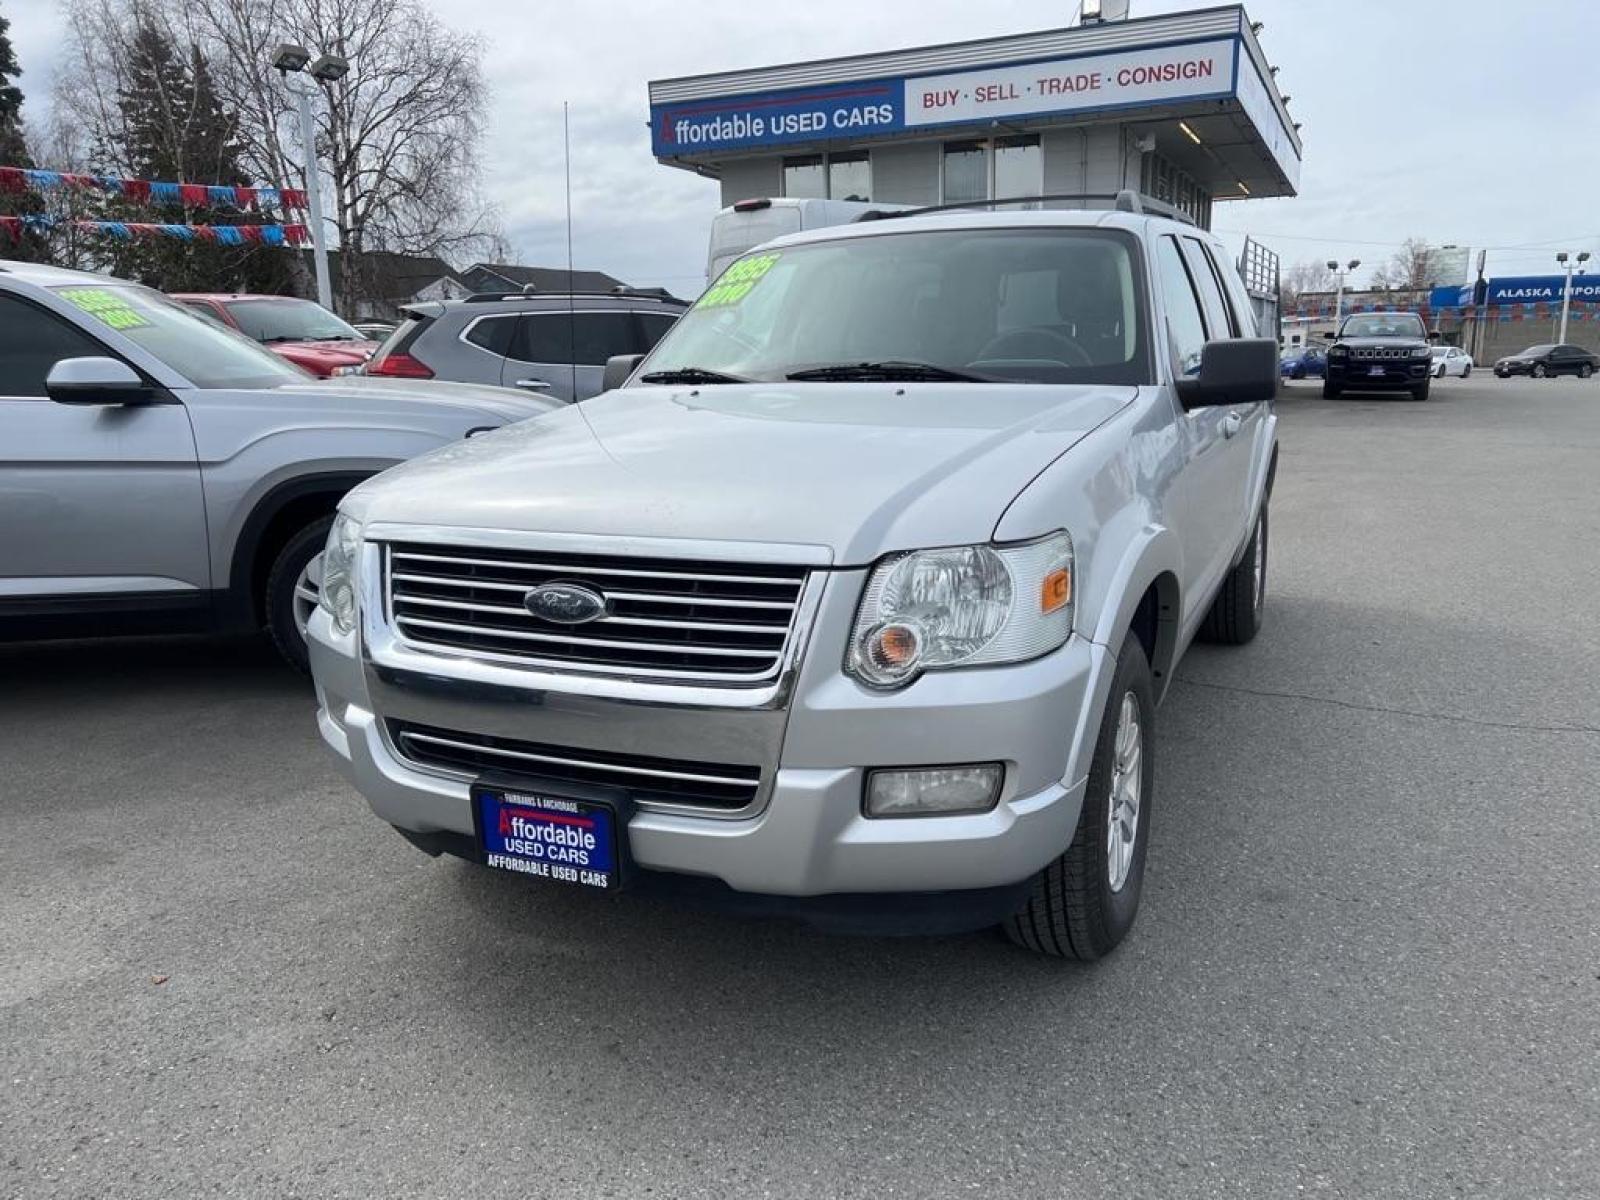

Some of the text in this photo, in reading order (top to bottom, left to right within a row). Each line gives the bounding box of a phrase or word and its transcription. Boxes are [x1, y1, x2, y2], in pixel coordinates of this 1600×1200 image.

[923, 59, 1212, 108] BUY SELL TRADE CONSIGN
[660, 104, 893, 145] Affordable USED CARS
[1496, 288, 1552, 298] ALASKA
[500, 808, 596, 850] Affordable
[505, 839, 589, 865] USED CARS
[488, 854, 608, 888] AFFORDABLE USED CARS
